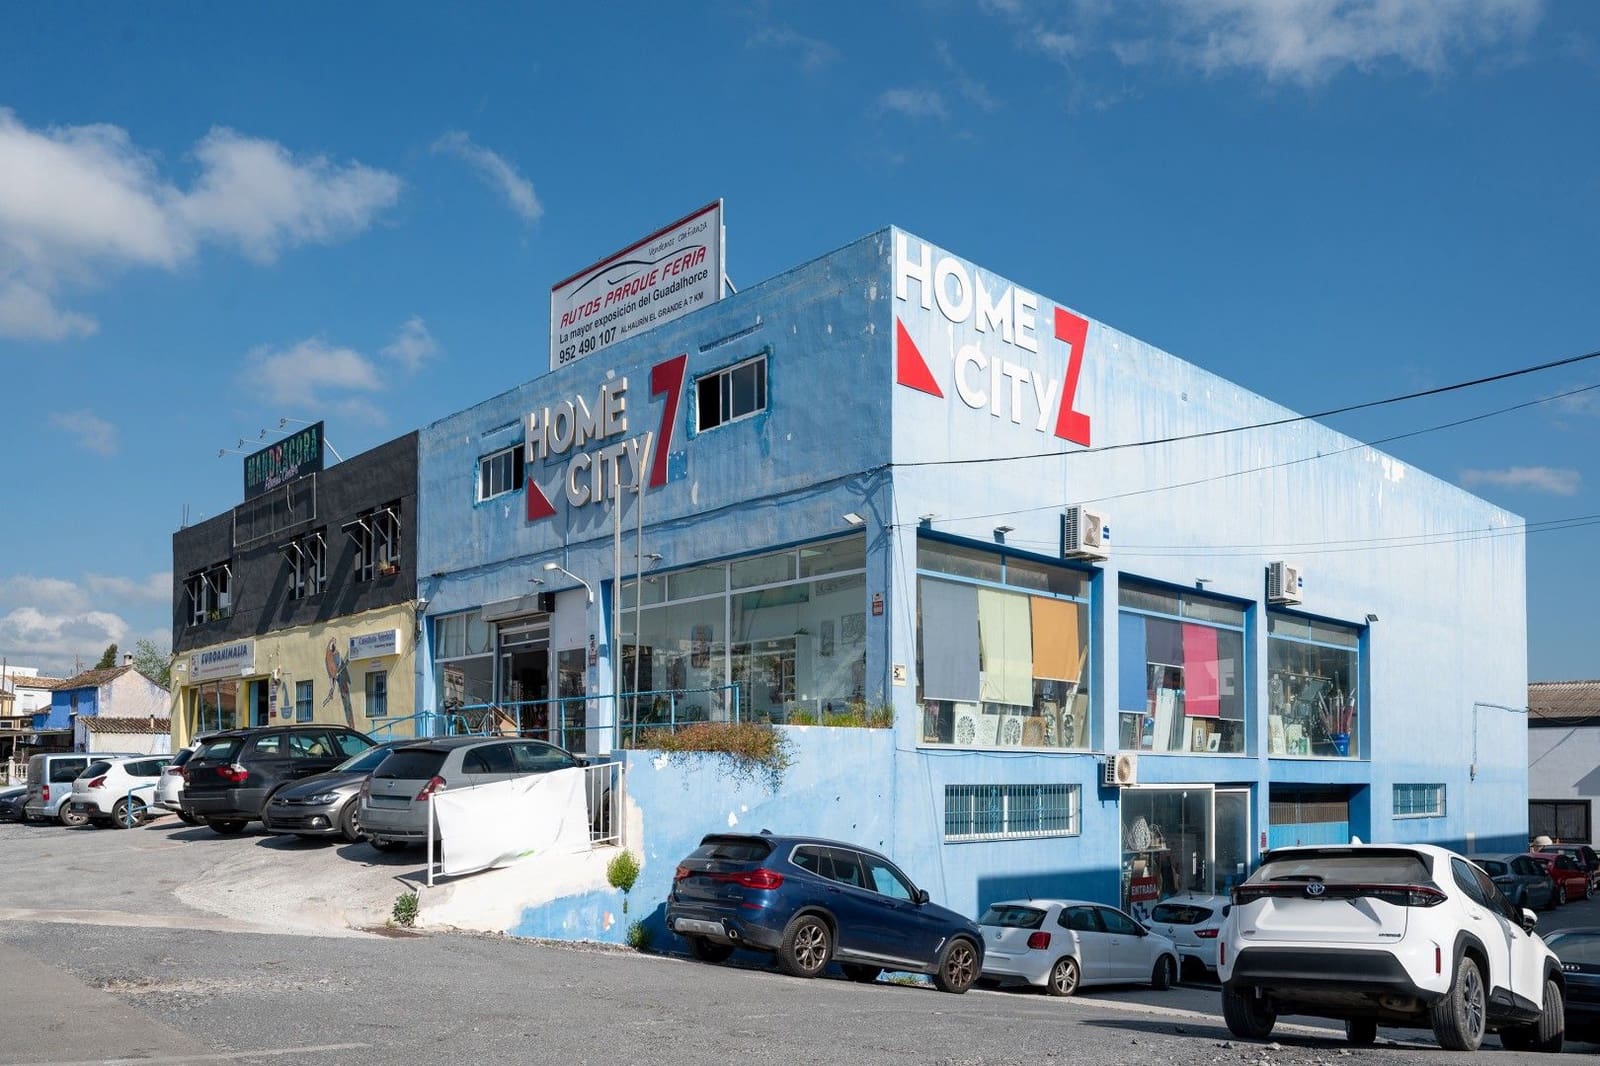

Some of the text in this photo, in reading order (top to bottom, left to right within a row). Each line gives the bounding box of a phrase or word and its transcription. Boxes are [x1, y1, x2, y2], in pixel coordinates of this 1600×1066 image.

[559, 269, 708, 345] La mayor exposición del Guadalhorce
[560, 246, 706, 329] AUTOS PARQUE FERIA
[649, 312, 657, 321] EL
[658, 301, 682, 318] GRANDE
[694, 291, 704, 302] KM
[895, 231, 1038, 354] HOME
[559, 326, 617, 364] 952 490 107
[525, 377, 627, 463] HOME
[954, 343, 1059, 433] CITY
[565, 432, 653, 507] CITY
[201, 644, 248, 665] EUROANIMALIA
[1131, 884, 1157, 896] ENTRADA
